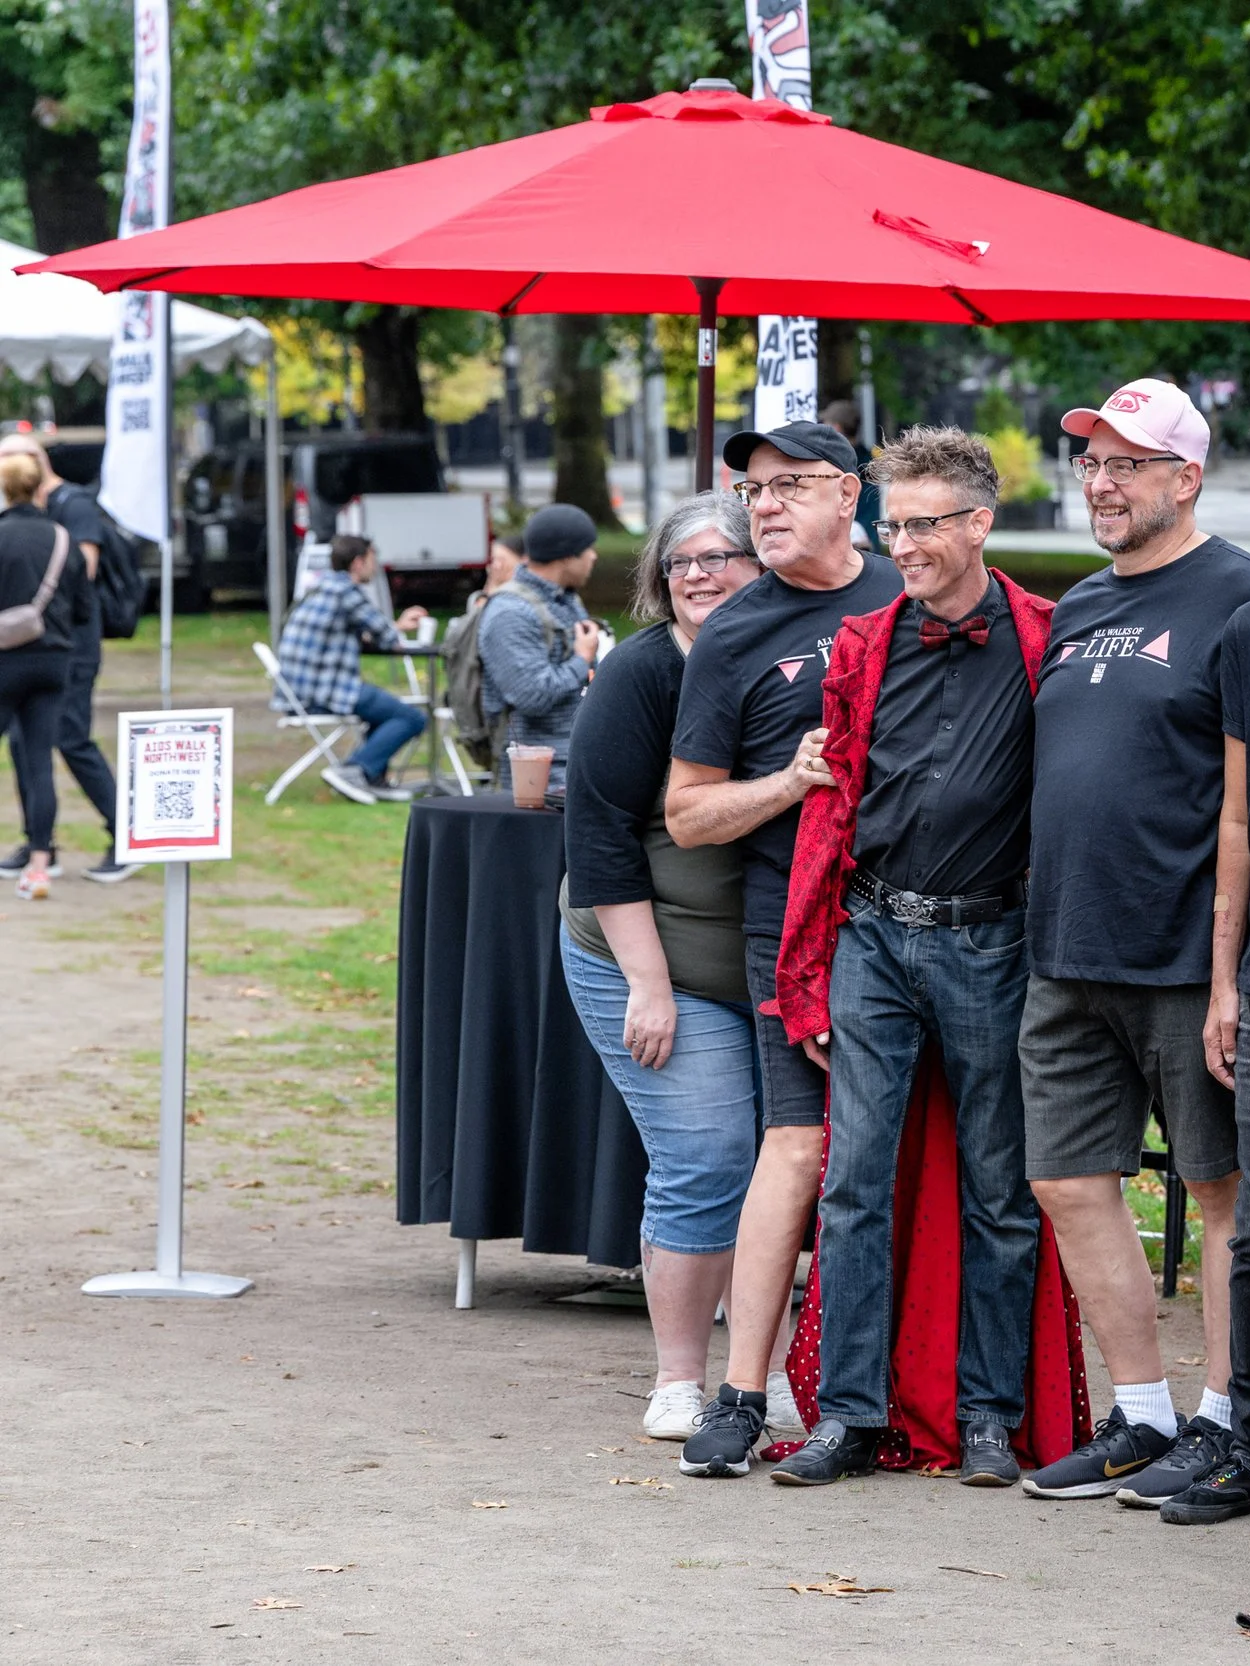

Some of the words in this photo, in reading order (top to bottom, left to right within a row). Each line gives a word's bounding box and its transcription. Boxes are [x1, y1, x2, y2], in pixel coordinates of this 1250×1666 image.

[1093, 628, 1106, 638] ALL
[1107, 627, 1132, 637] WALKS
[1132, 626, 1145, 635] OF
[1081, 636, 1140, 658] LIFE
[145, 741, 171, 752] AIDS
[175, 740, 206, 751] WALK
[144, 751, 207, 764] NORTHWEST
